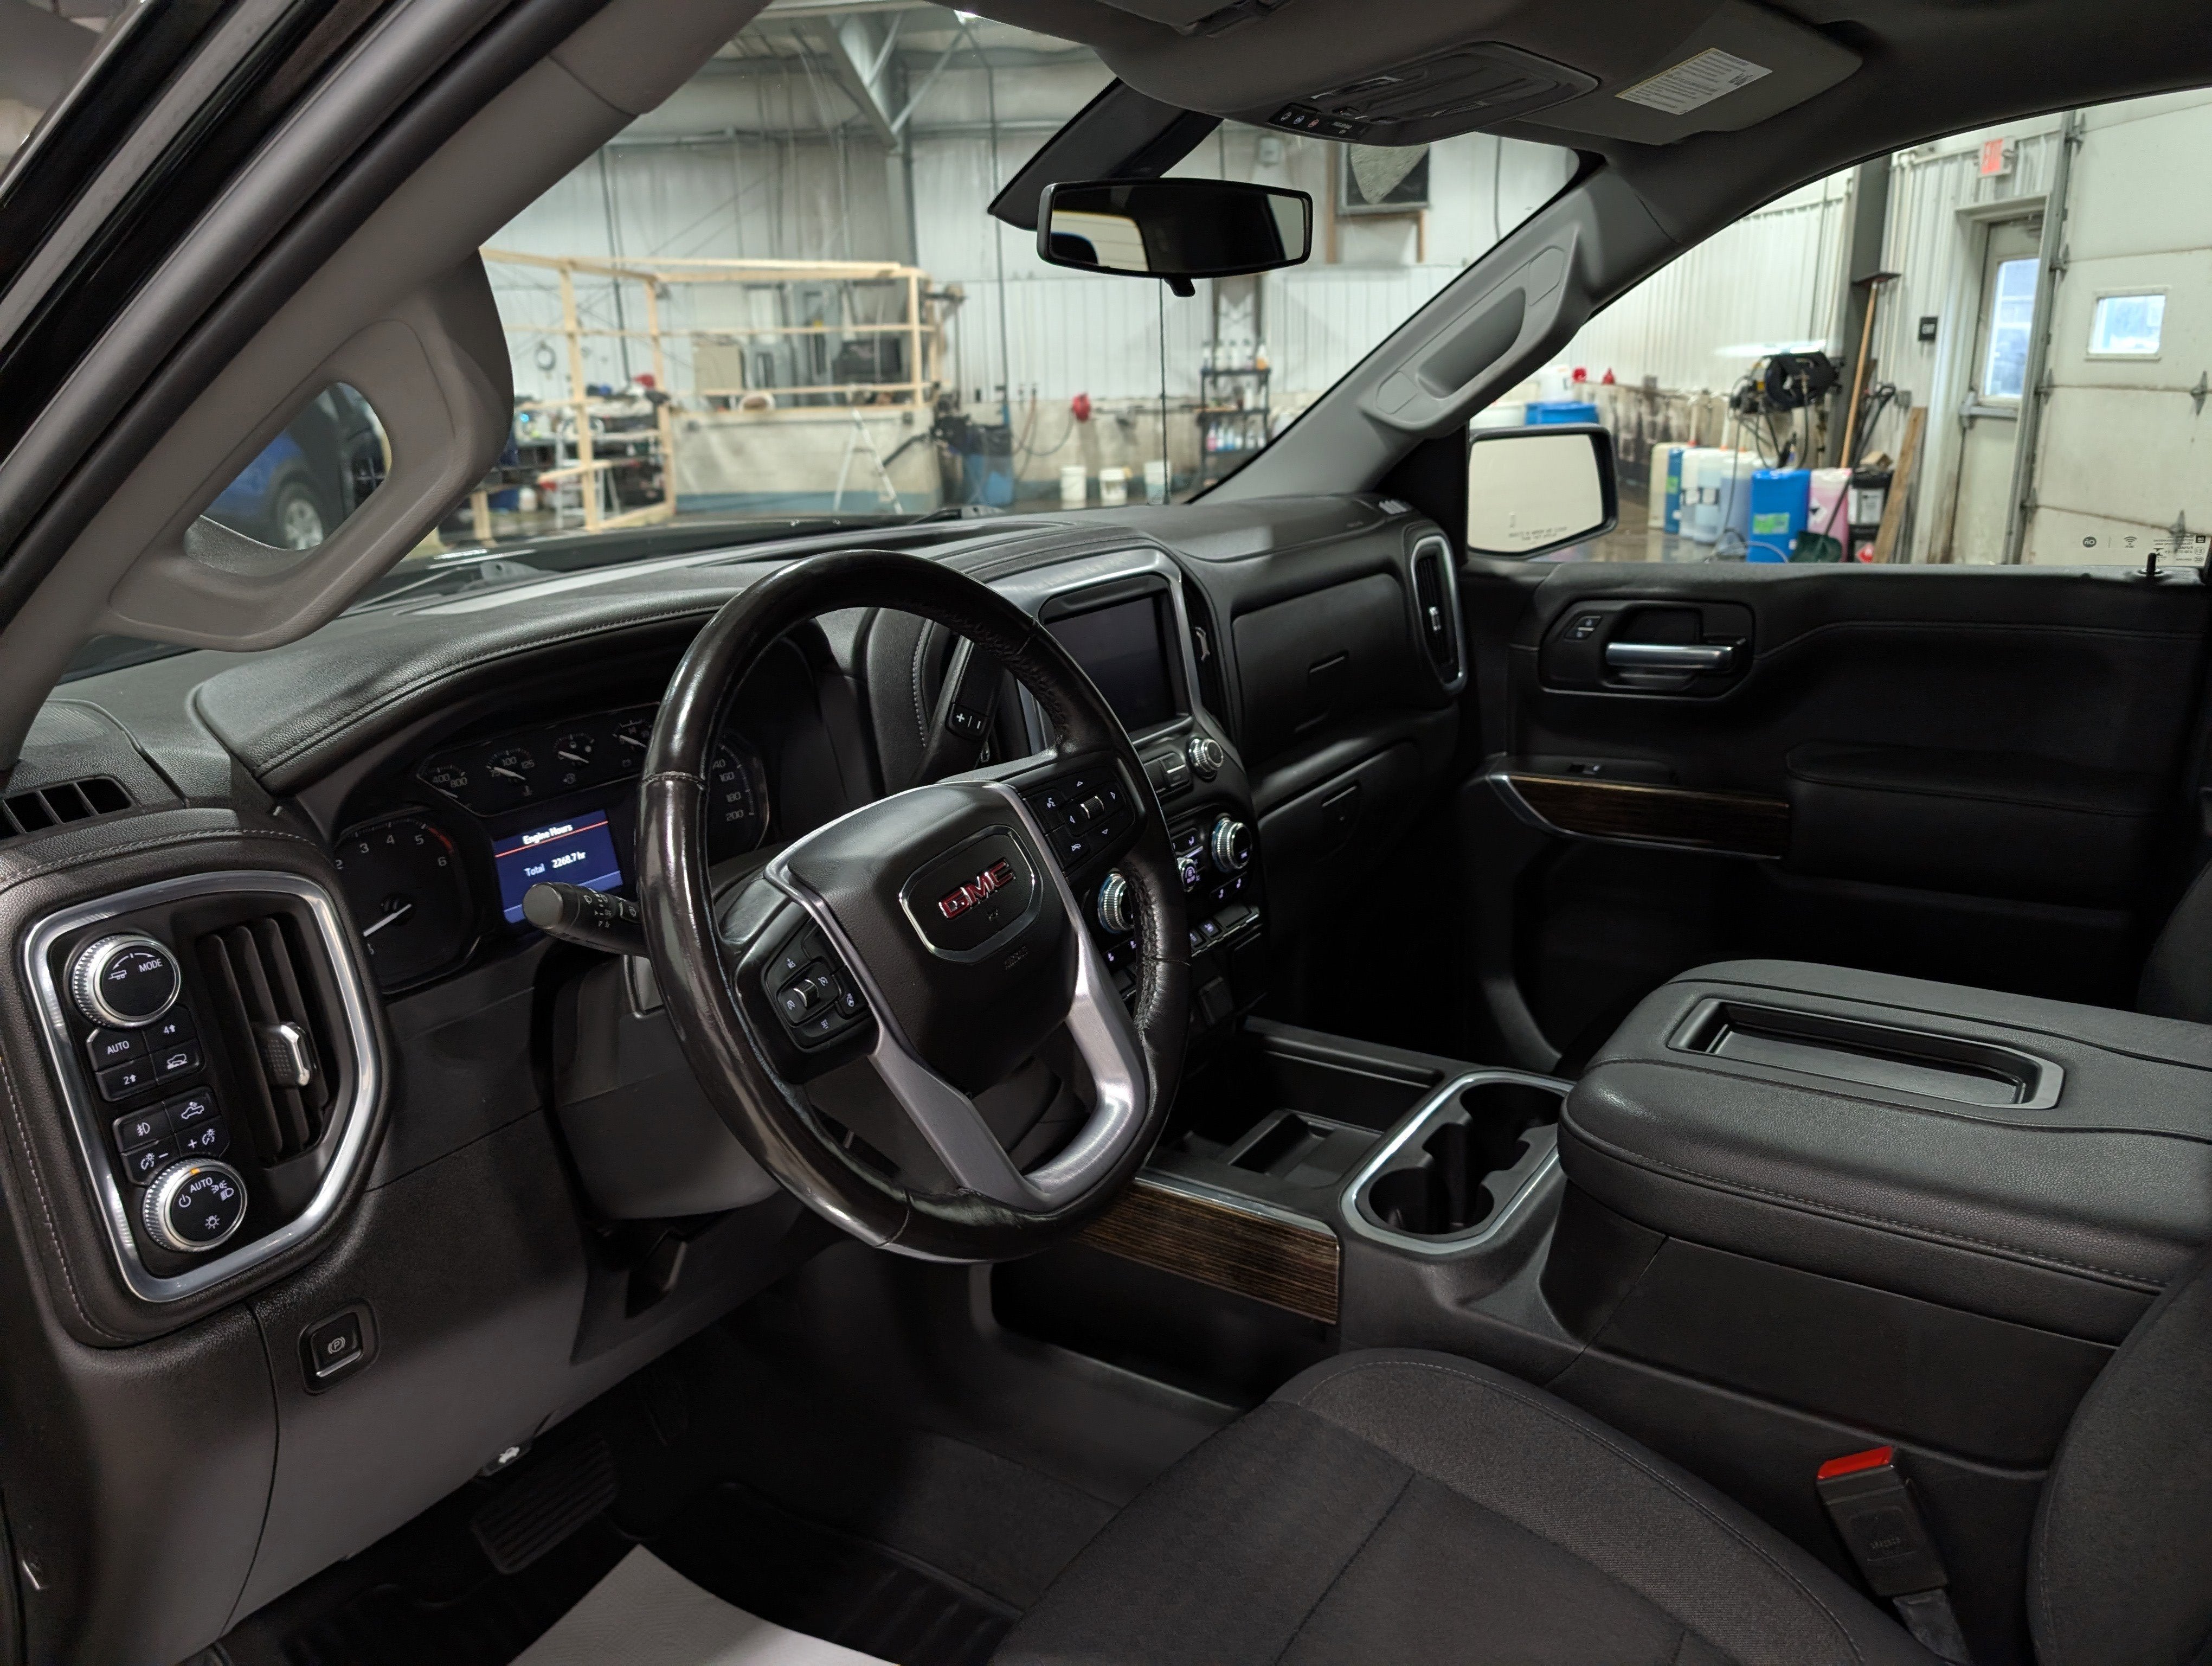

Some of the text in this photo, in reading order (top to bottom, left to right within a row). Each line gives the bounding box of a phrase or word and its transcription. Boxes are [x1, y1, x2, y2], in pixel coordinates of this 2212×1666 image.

[726, 809, 744, 822] 200
[386, 835, 395, 844] 4
[414, 835, 425, 845] 5
[522, 824, 573, 844] Engine Hours
[359, 843, 369, 854] 3
[335, 860, 344, 869] 2
[438, 856, 448, 867] 6
[524, 851, 586, 876] Total 2268.7 hr
[938, 857, 1016, 919] GMC
[139, 958, 163, 973] MODE
[107, 1040, 130, 1055] AUTO
[190, 1177, 213, 1194] AUTO
